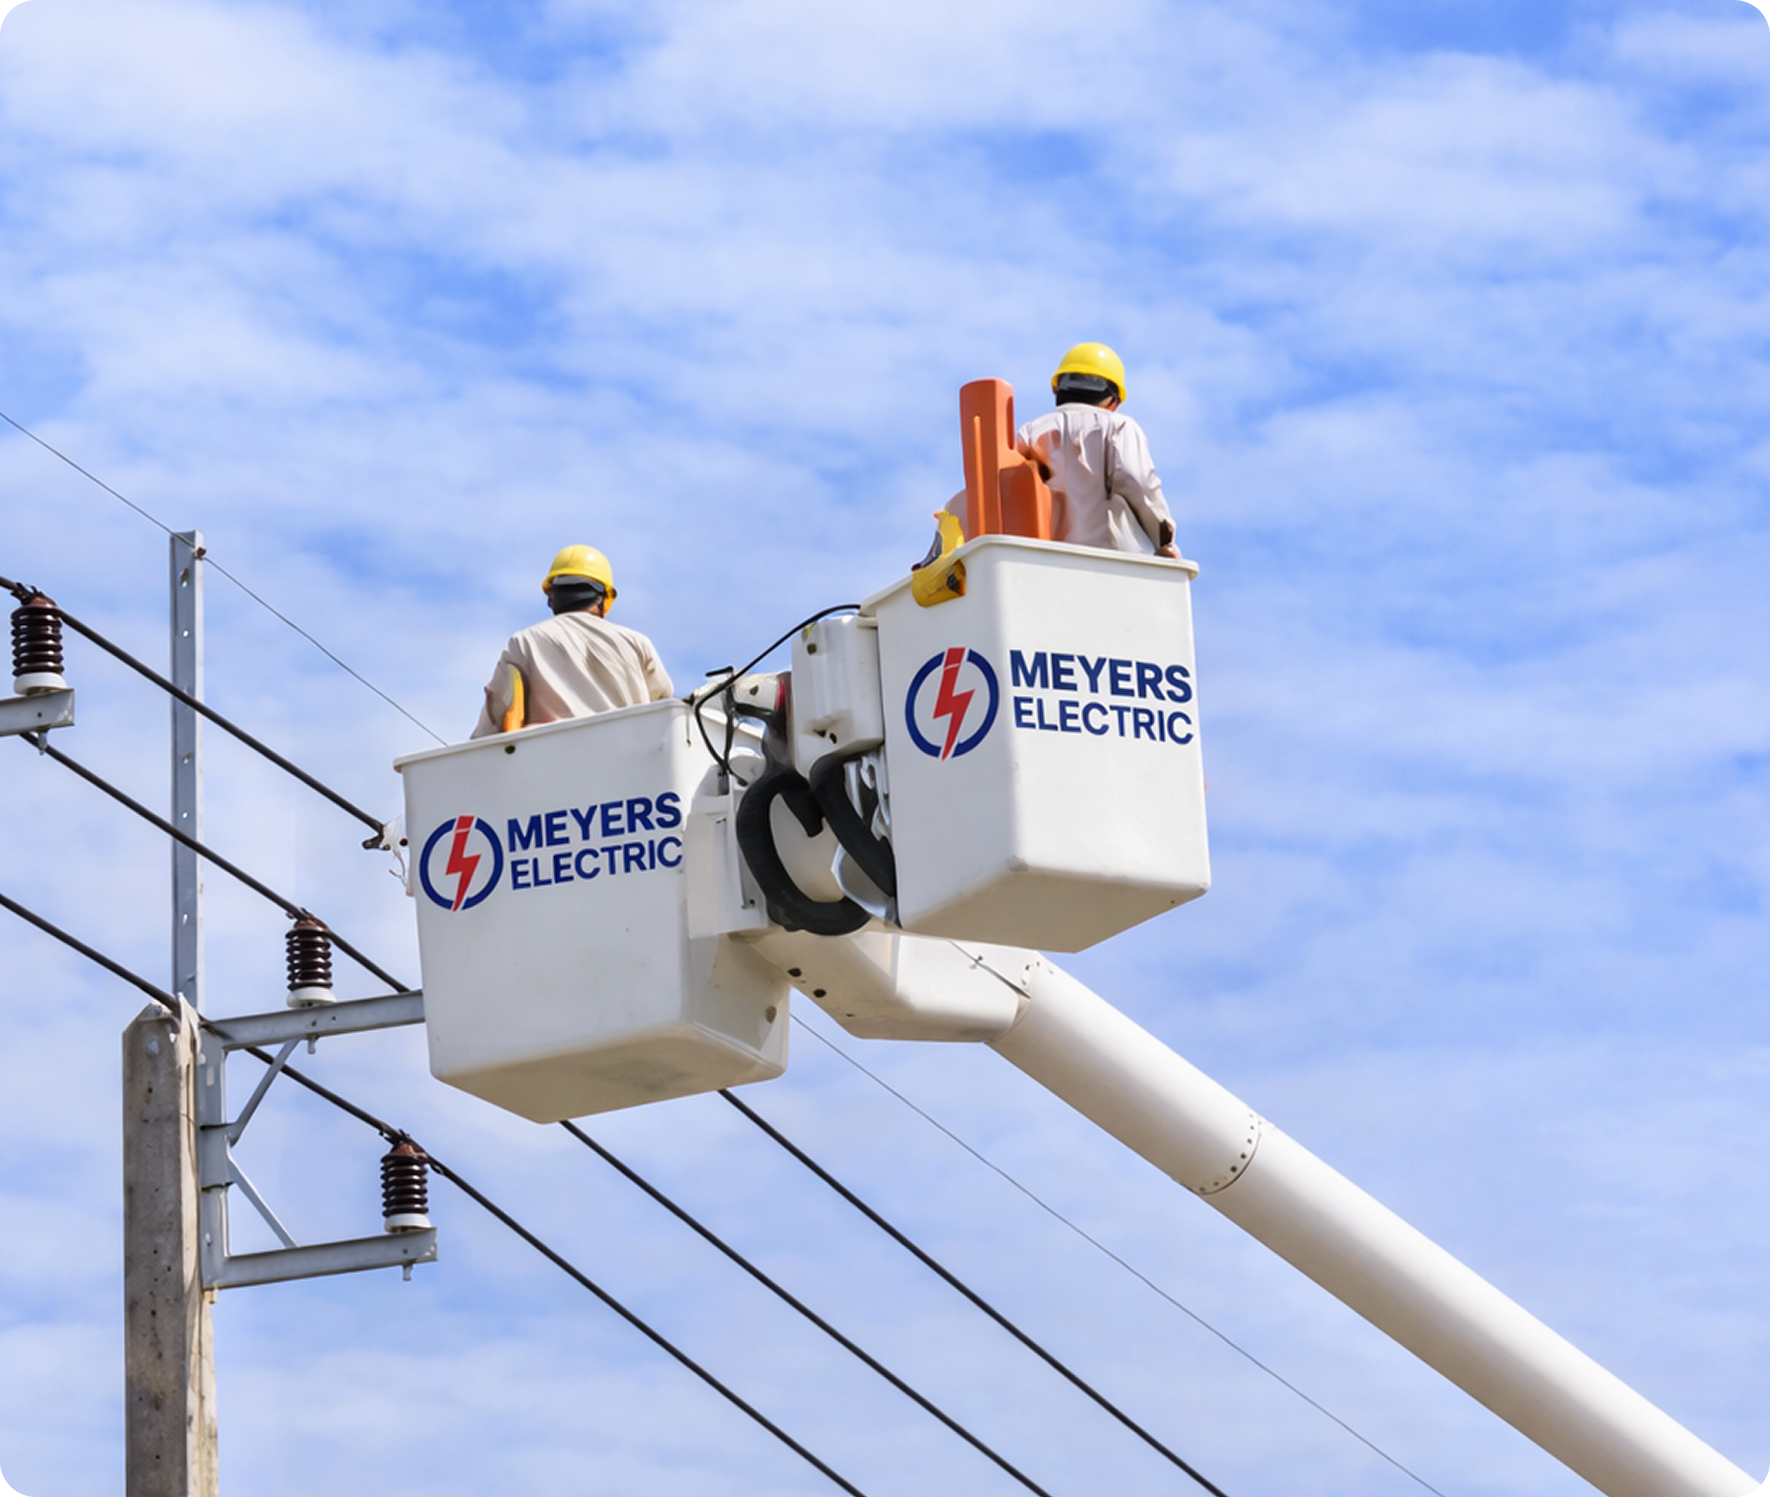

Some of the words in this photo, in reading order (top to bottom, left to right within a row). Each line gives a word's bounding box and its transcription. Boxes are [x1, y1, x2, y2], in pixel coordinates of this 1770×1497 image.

[1009, 649, 1192, 703] MEYERS
[1013, 696, 1194, 745] ELECTRIC
[507, 792, 682, 853] MEYERS
[511, 836, 683, 891] ELECTRIC
